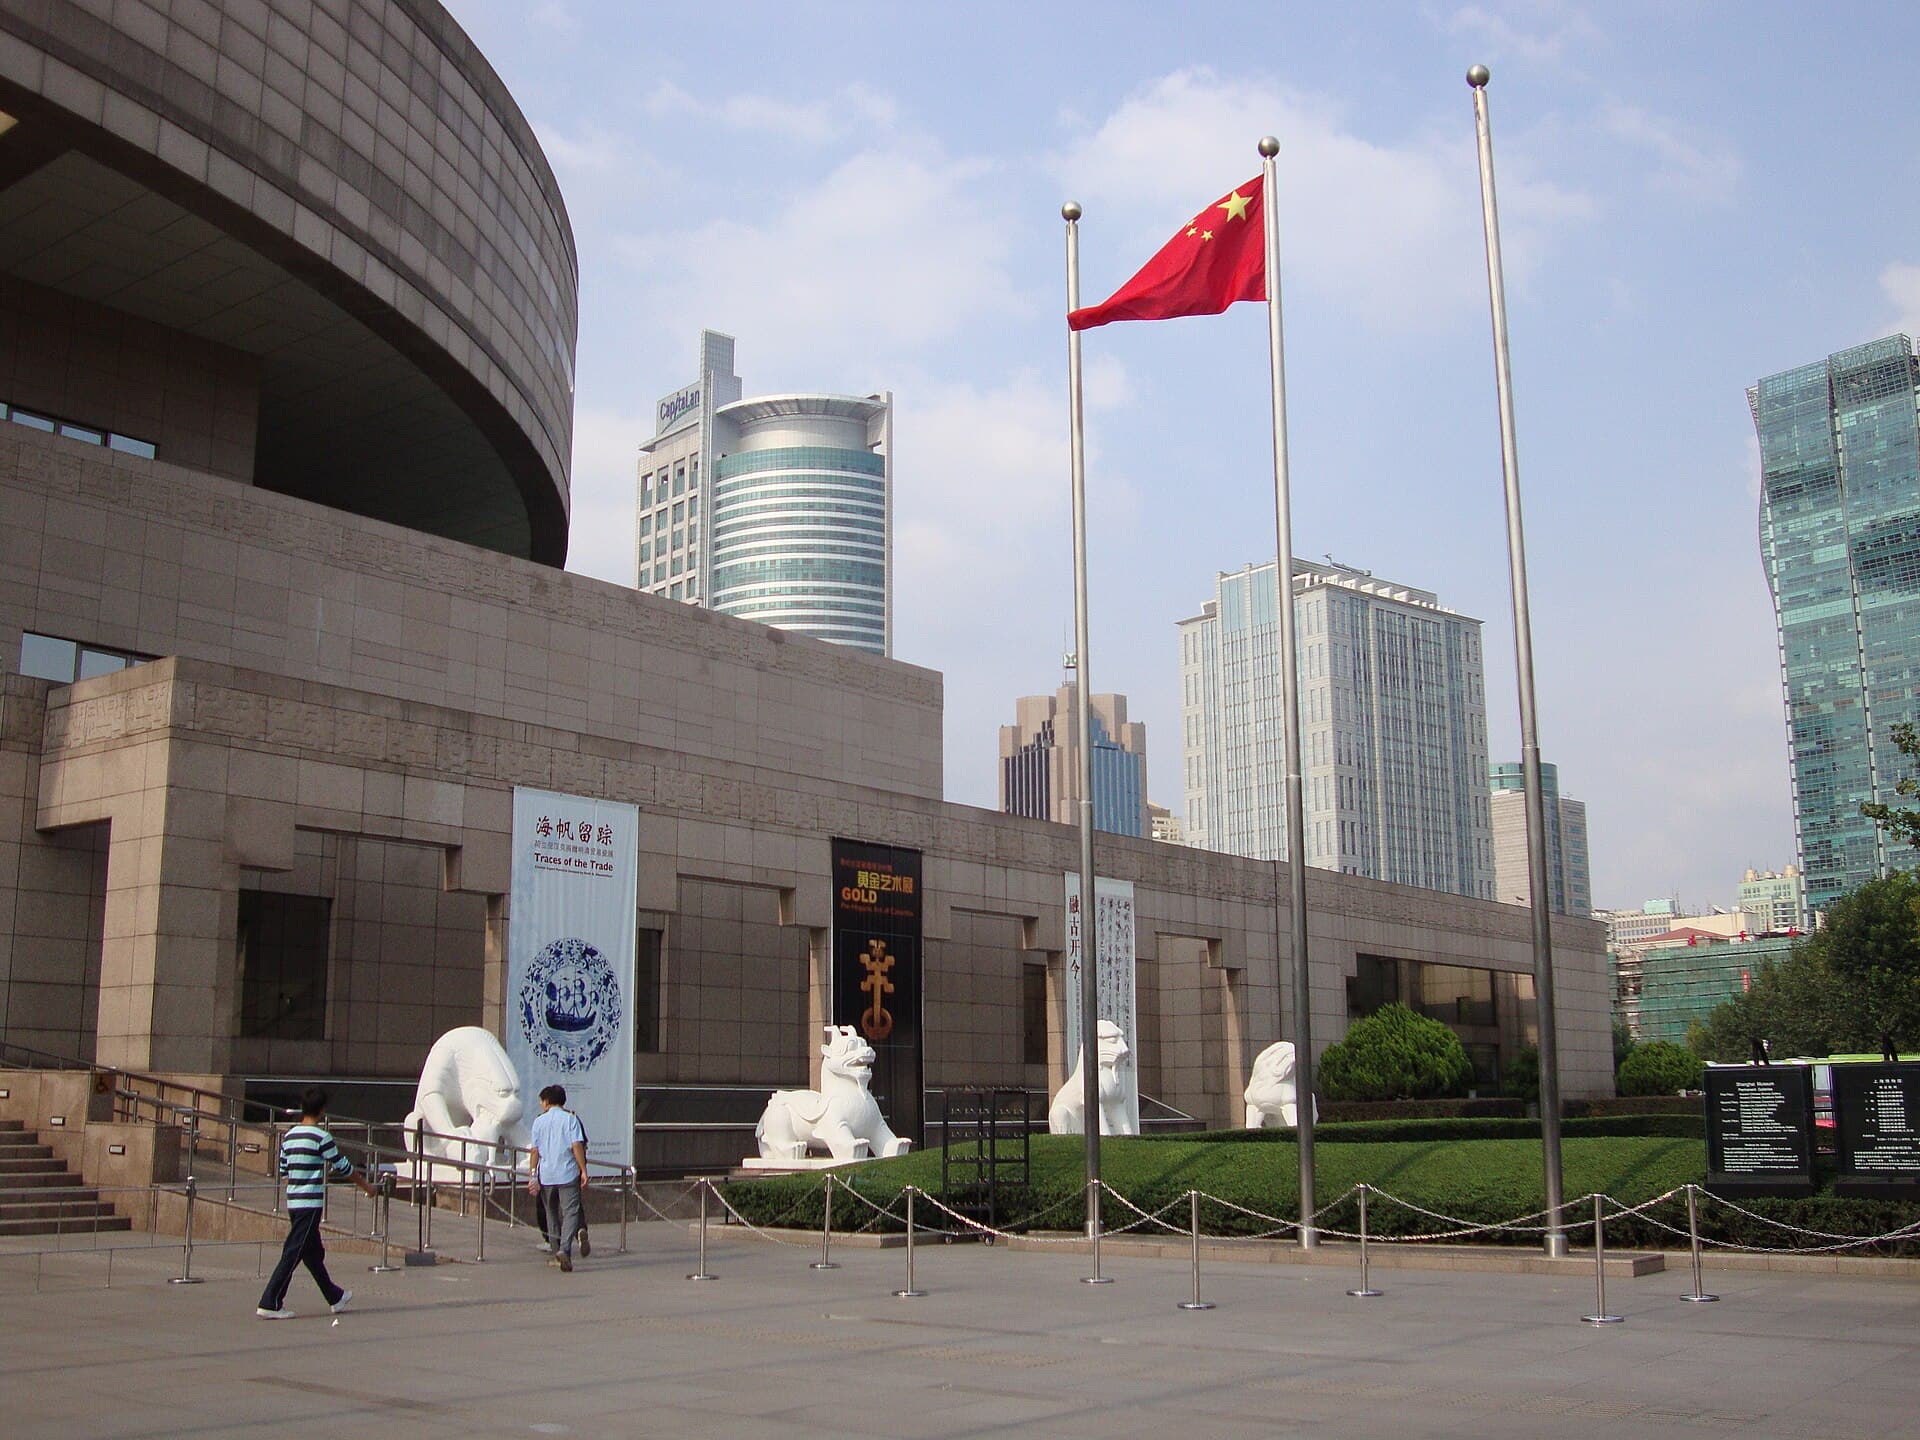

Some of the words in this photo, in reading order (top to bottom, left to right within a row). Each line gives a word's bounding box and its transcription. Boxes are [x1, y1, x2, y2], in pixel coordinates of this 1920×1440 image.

[660, 390, 700, 420] CapitaLan
[536, 815, 613, 846] 海帆留踪
[534, 852, 562, 865] Traces
[564, 857, 572, 867] of
[574, 858, 588, 869] the
[590, 860, 614, 872] Trade
[841, 887, 877, 903] GOLD
